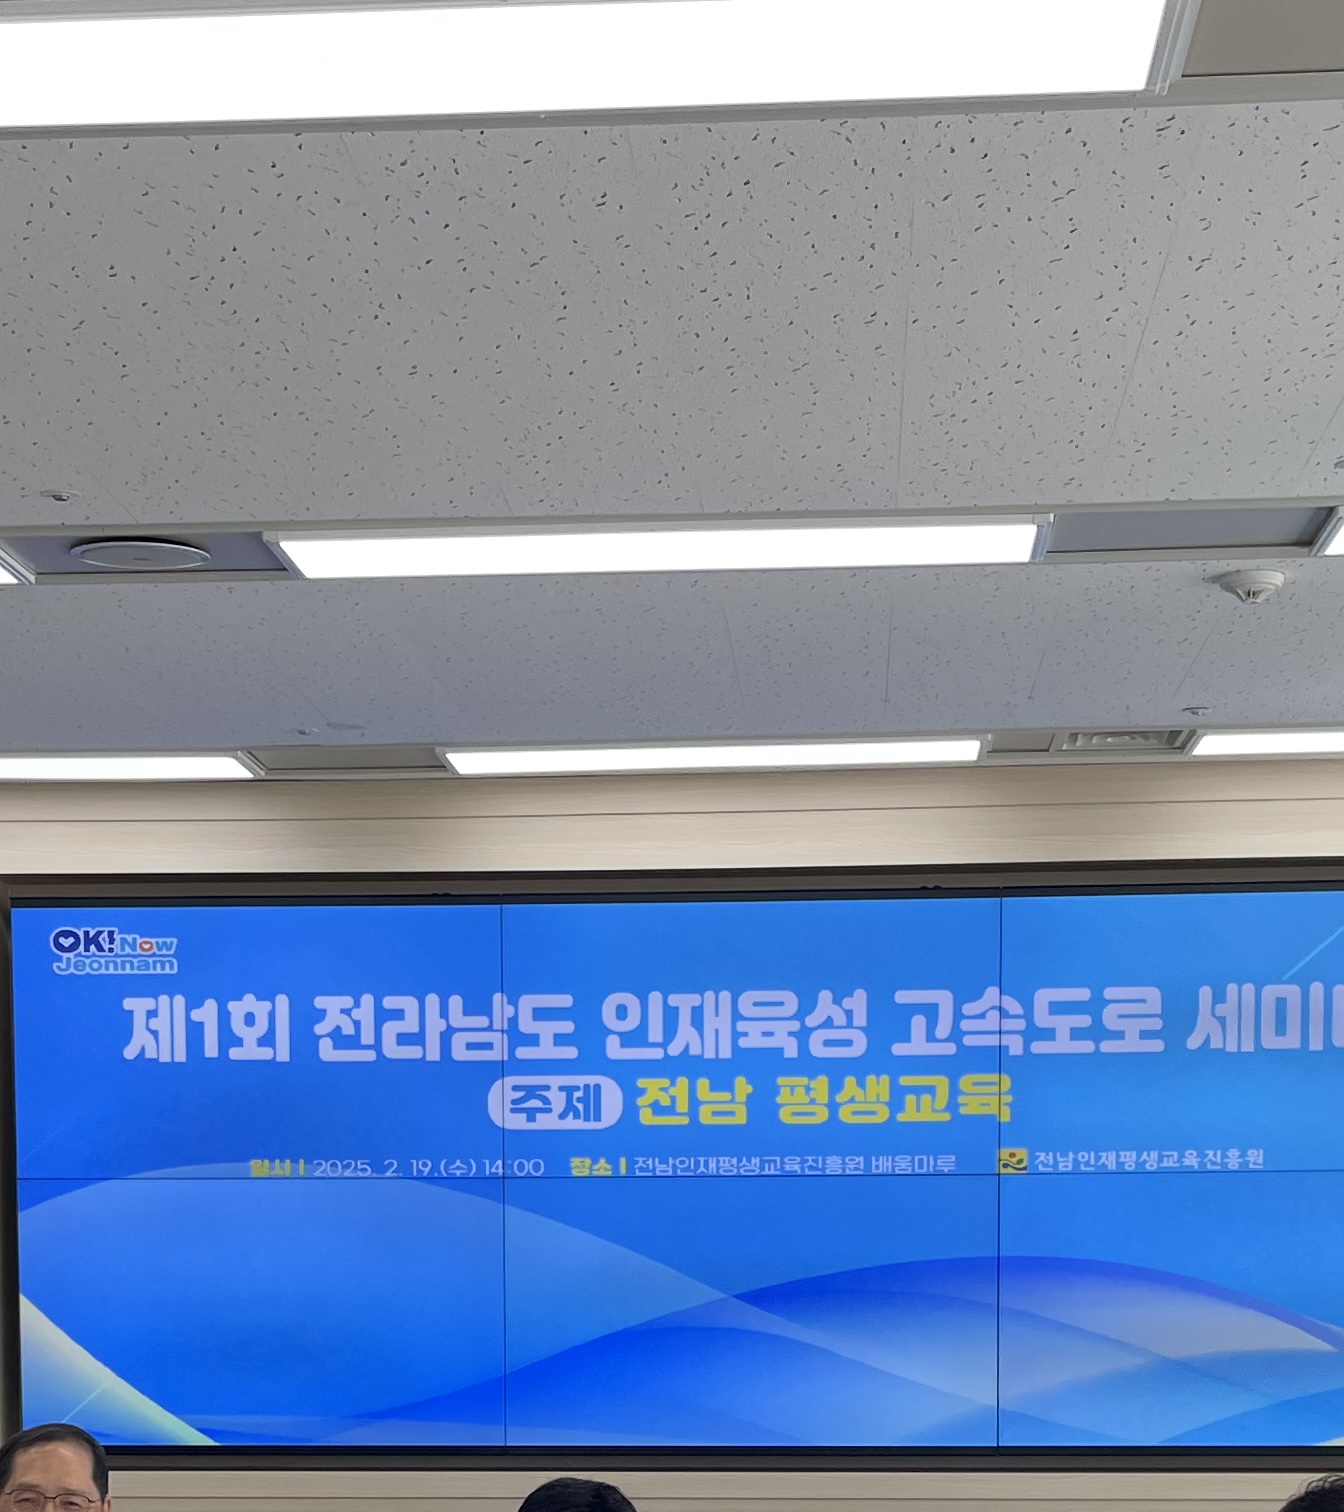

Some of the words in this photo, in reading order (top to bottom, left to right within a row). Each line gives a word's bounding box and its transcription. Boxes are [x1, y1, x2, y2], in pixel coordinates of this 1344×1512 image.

[52, 928, 117, 954] OK!
[119, 936, 176, 954] Now
[54, 955, 178, 974] Jeonnam
[122, 993, 291, 1063] 제1회
[313, 992, 579, 1062] 전라남도
[601, 989, 869, 1060] 인재육성
[891, 985, 1165, 1056] 고속도로
[509, 1084, 603, 1124] 주제
[635, 1075, 753, 1126] 전남
[776, 1073, 1013, 1125] 평생교육
[313, 1159, 376, 1177] 2025.
[384, 1159, 403, 1177] 2.
[410, 1158, 476, 1178] 19.(수)
[483, 1159, 545, 1177] 14:00
[634, 1156, 864, 1175] 전남인재평생교육진흥원
[871, 1155, 956, 1174] 배움마루
[1034, 1149, 1264, 1171] 전남인재평생교육진흥원
